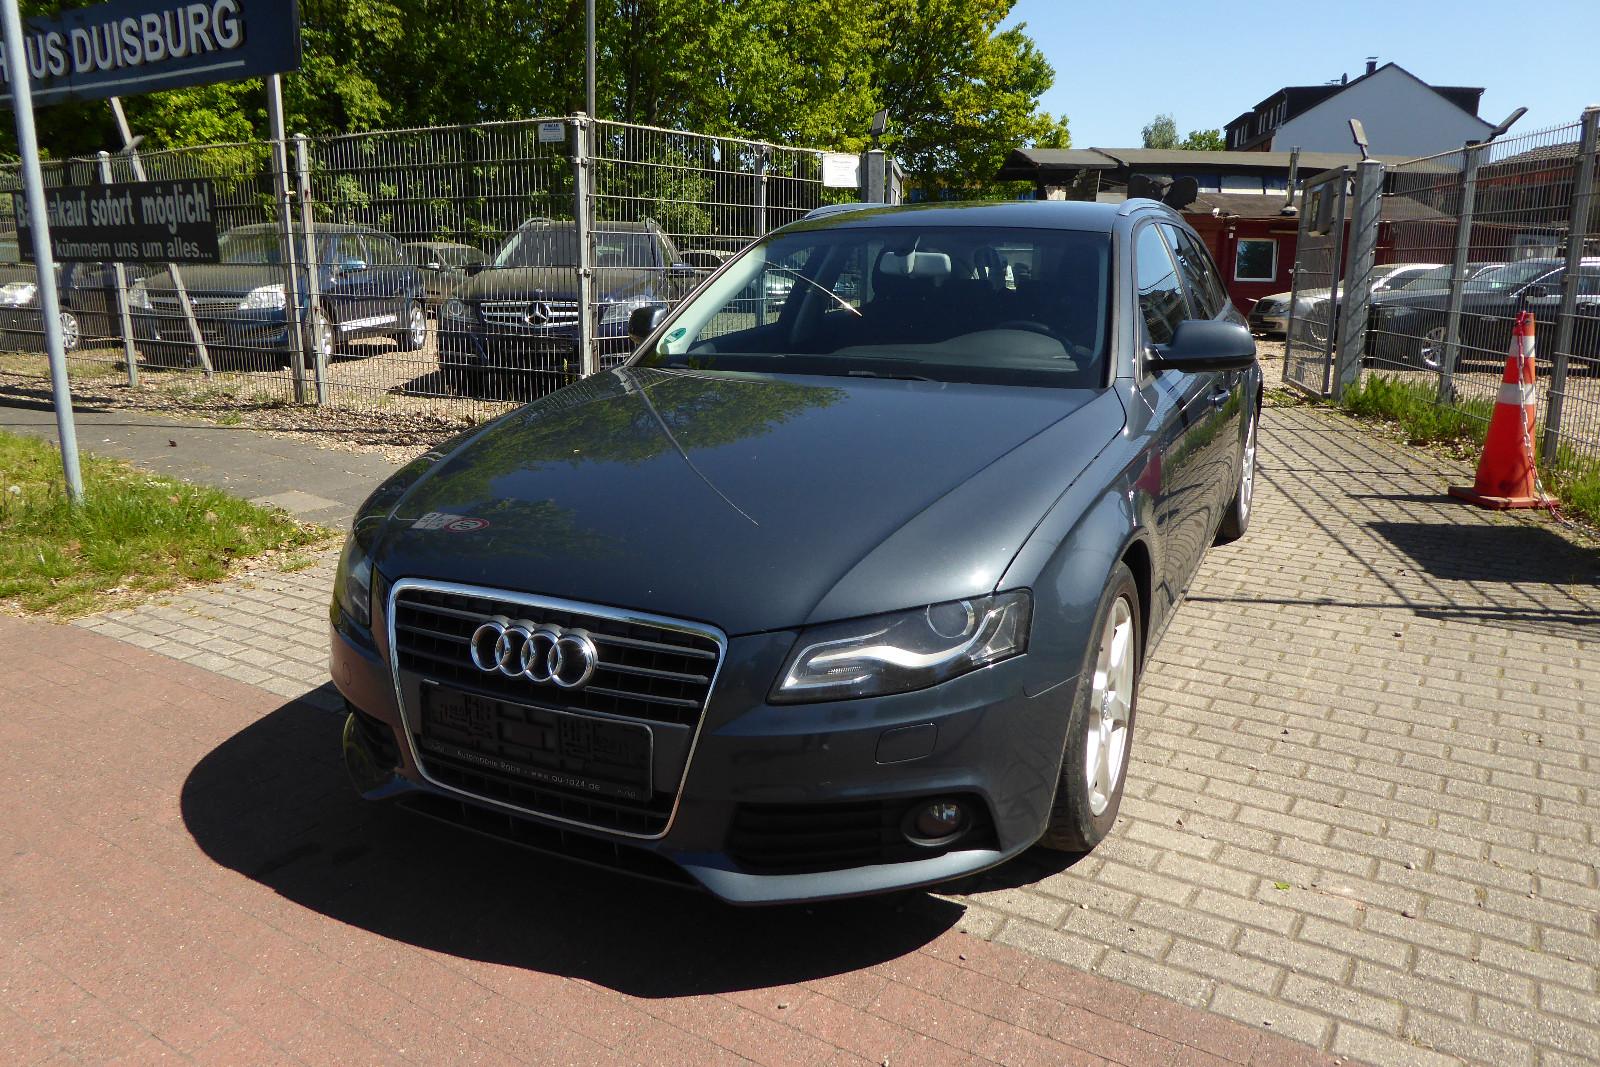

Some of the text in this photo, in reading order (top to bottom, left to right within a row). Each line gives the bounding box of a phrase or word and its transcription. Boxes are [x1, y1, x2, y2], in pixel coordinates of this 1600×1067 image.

[0, 0, 241, 82] US DUISBURG
[90, 189, 135, 226] sofort
[141, 181, 211, 234] möglich!
[55, 239, 112, 258] kümmern
[114, 241, 139, 258] uns
[142, 241, 163, 258] um
